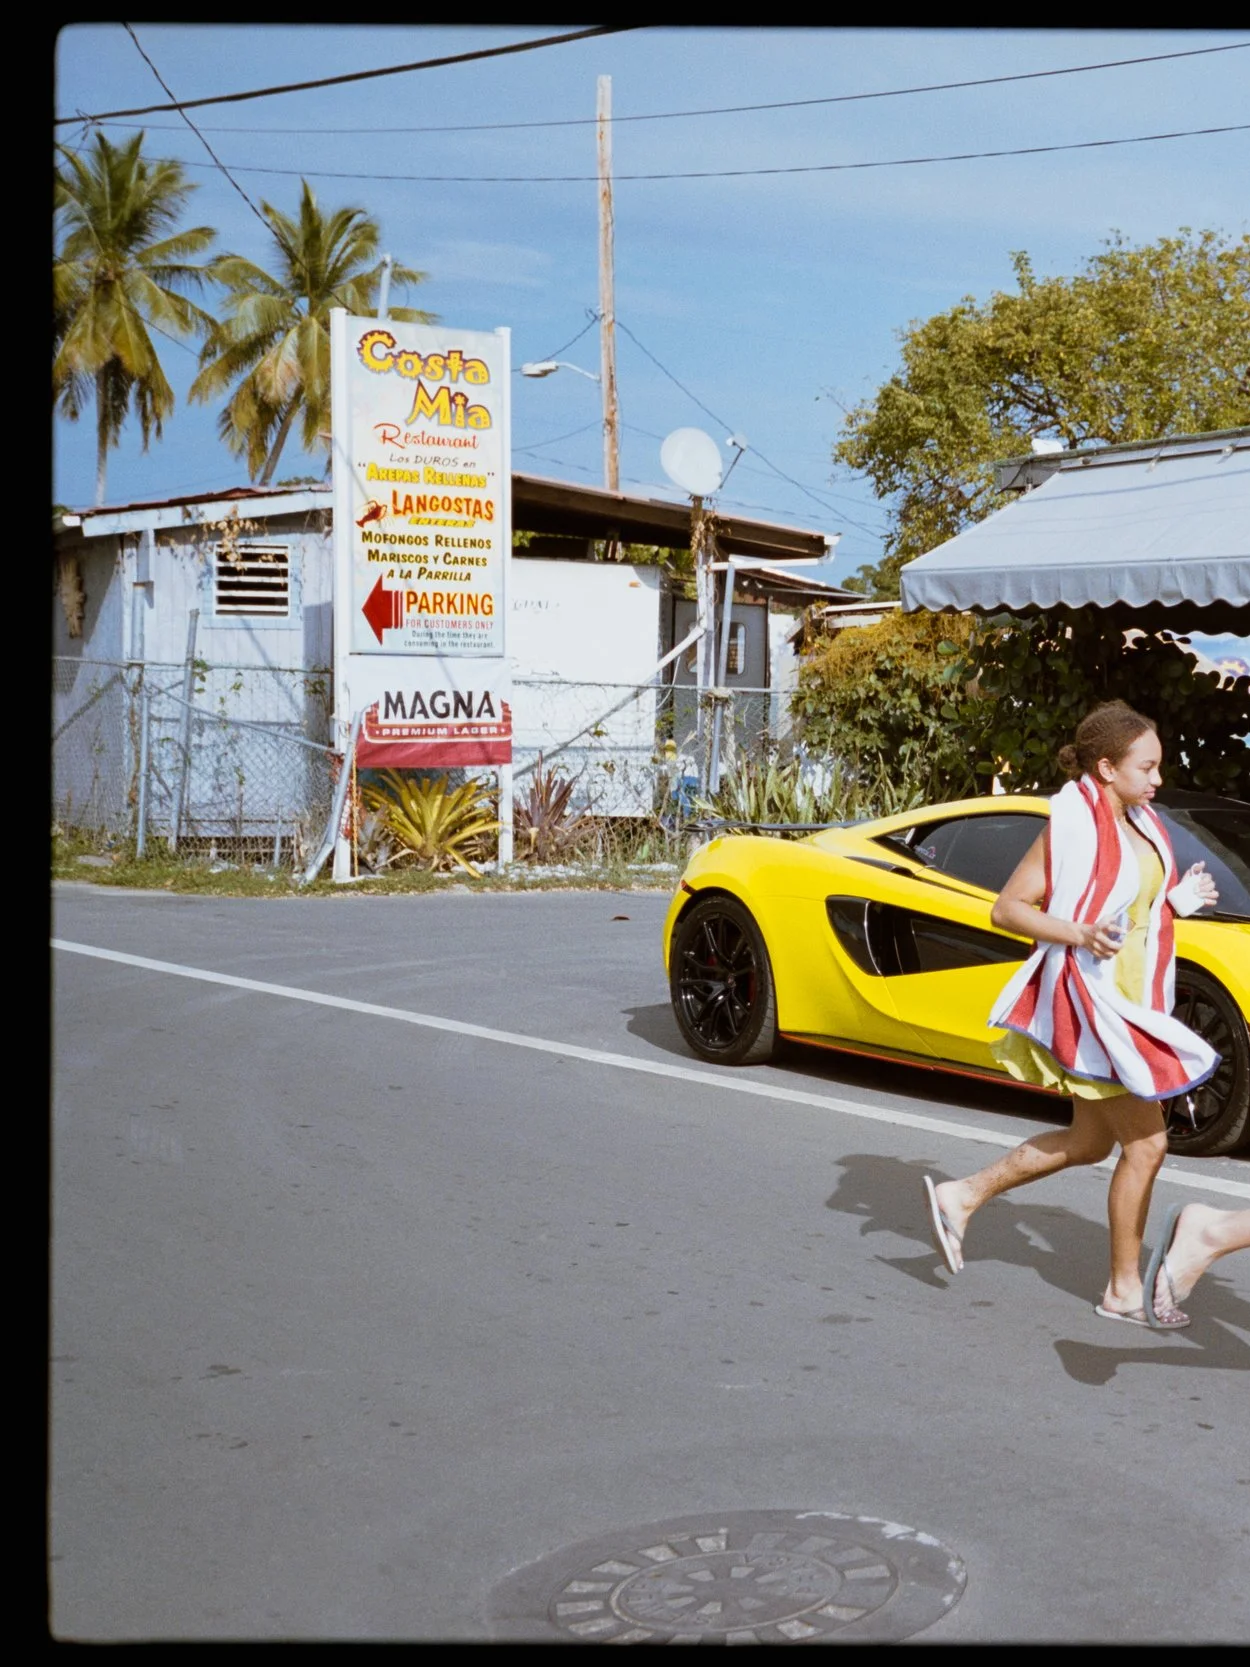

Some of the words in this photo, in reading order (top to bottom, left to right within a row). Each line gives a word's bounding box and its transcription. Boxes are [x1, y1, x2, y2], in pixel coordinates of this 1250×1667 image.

[356, 329, 491, 385] Costa
[405, 378, 492, 430] Mia
[373, 422, 479, 449] Restaurant
[389, 453, 410, 464] Los
[414, 455, 459, 468] DUROS
[391, 488, 495, 522] LANGOSTAS
[361, 530, 429, 547] MOFONGOS
[434, 533, 492, 549] RELLENOS
[367, 548, 429, 565] MARISCOS
[443, 551, 488, 567] CARNES
[386, 568, 395, 579] A
[399, 568, 412, 580] LA
[417, 566, 472, 582] PARRILLA
[405, 589, 494, 616] PARKING
[405, 618, 421, 628] FOR
[424, 619, 473, 629] CUSTOMERS
[475, 620, 494, 631] ONLY
[412, 630, 433, 639] During
[463, 631, 476, 640] they
[384, 690, 496, 719] MAGNA
[382, 727, 448, 736] PREMIUM
[453, 726, 498, 735] LAGER
